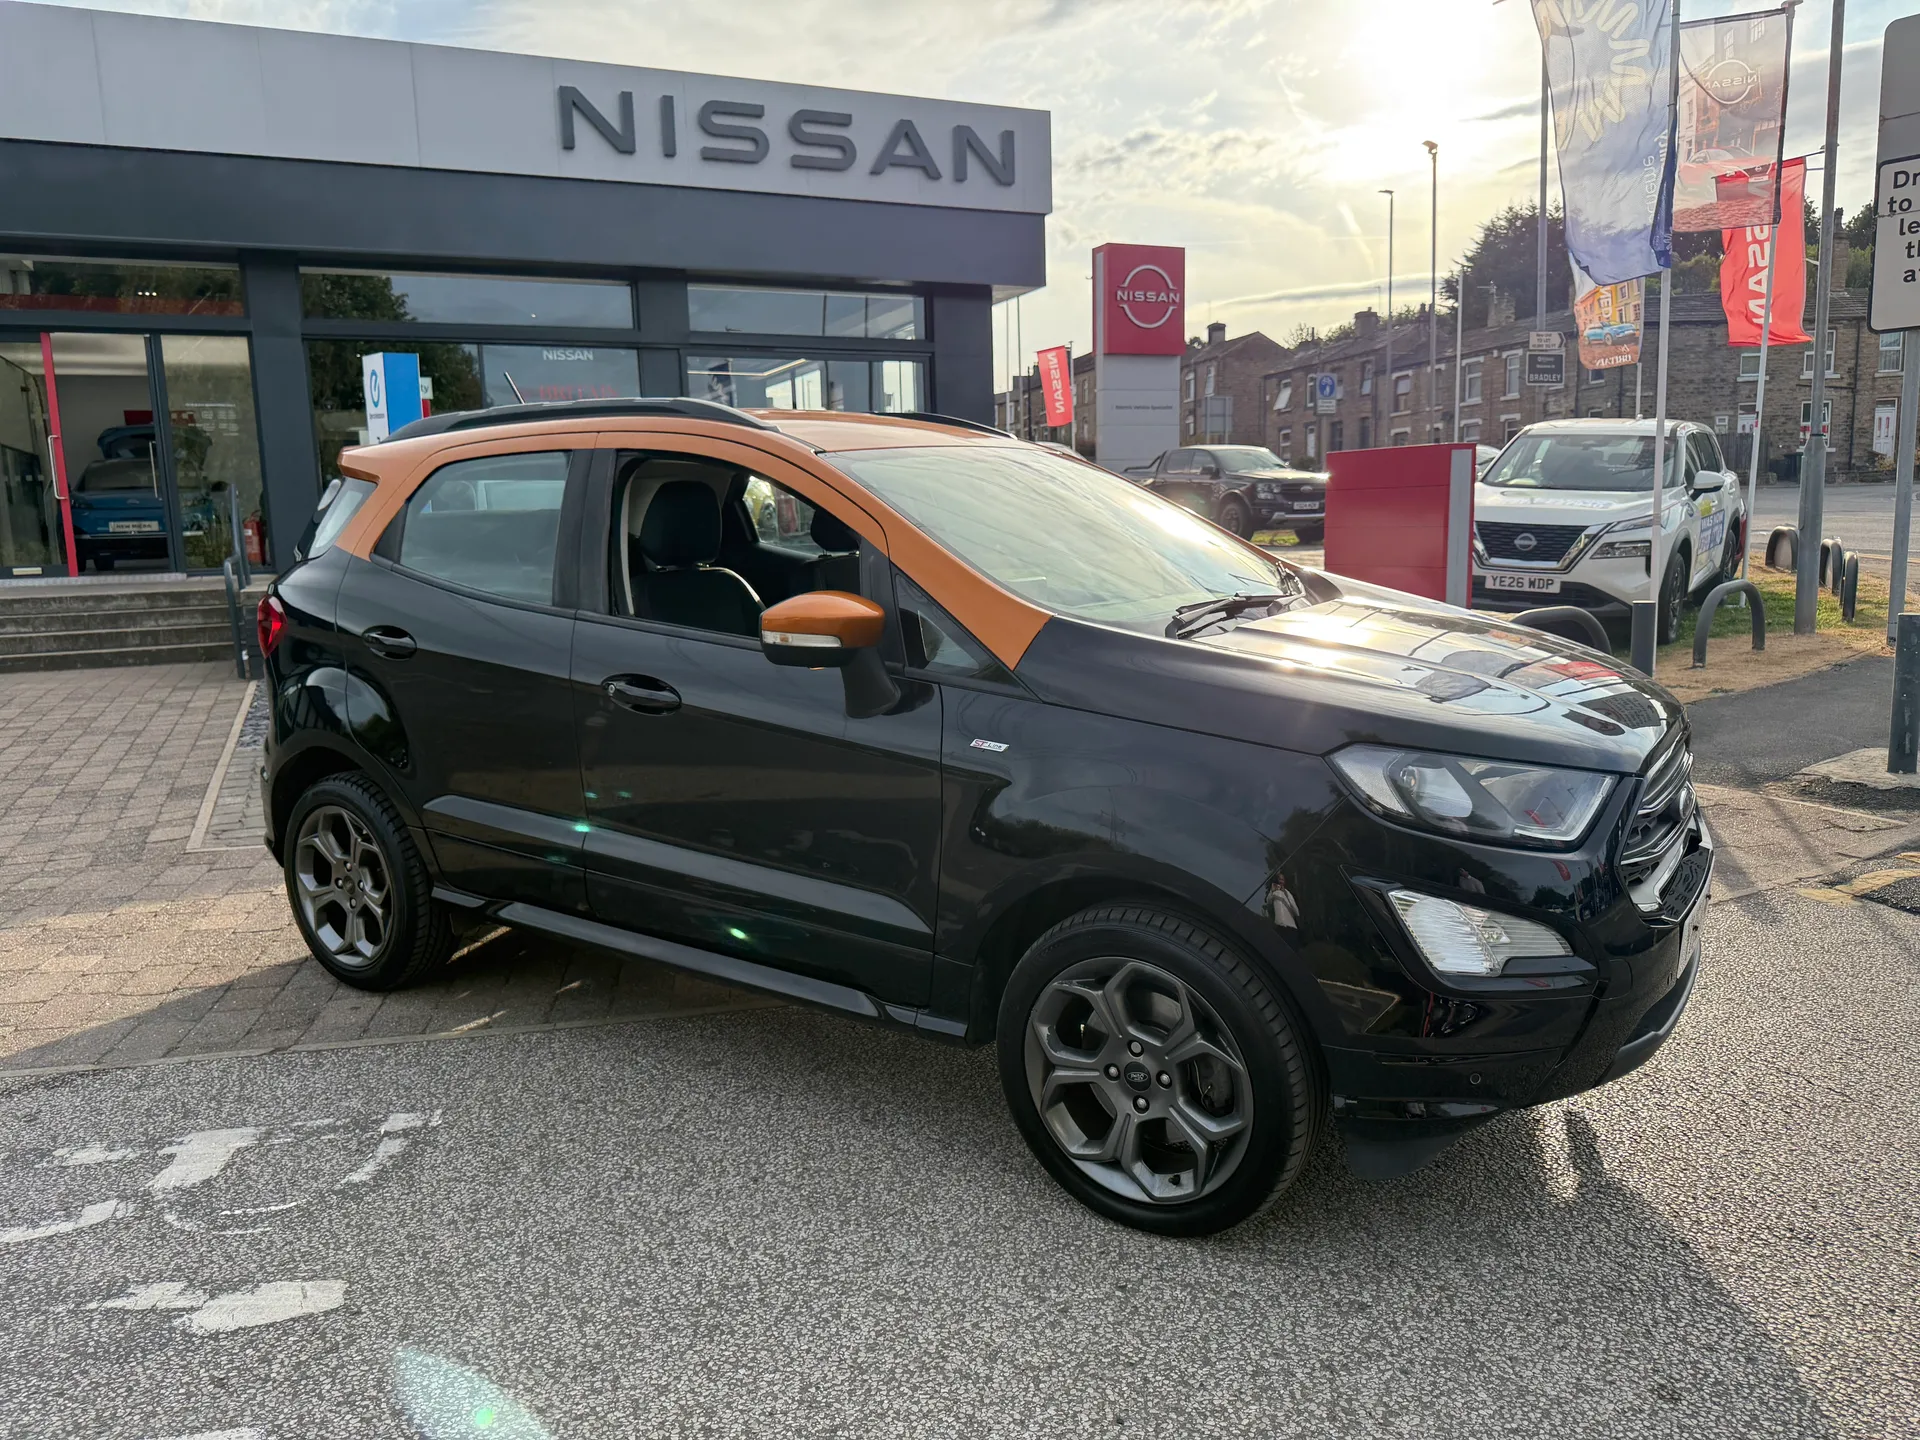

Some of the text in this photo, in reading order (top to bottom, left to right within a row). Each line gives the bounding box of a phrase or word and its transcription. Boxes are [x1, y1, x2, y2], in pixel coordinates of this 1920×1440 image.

[558, 85, 1016, 187] NISSAN
[1887, 196, 1912, 213] to
[1116, 290, 1180, 303] NISSAN
[543, 349, 594, 360] NISSAN
[1530, 373, 1561, 381] BRADLEY
[1491, 575, 1555, 590] YE26 WDP
